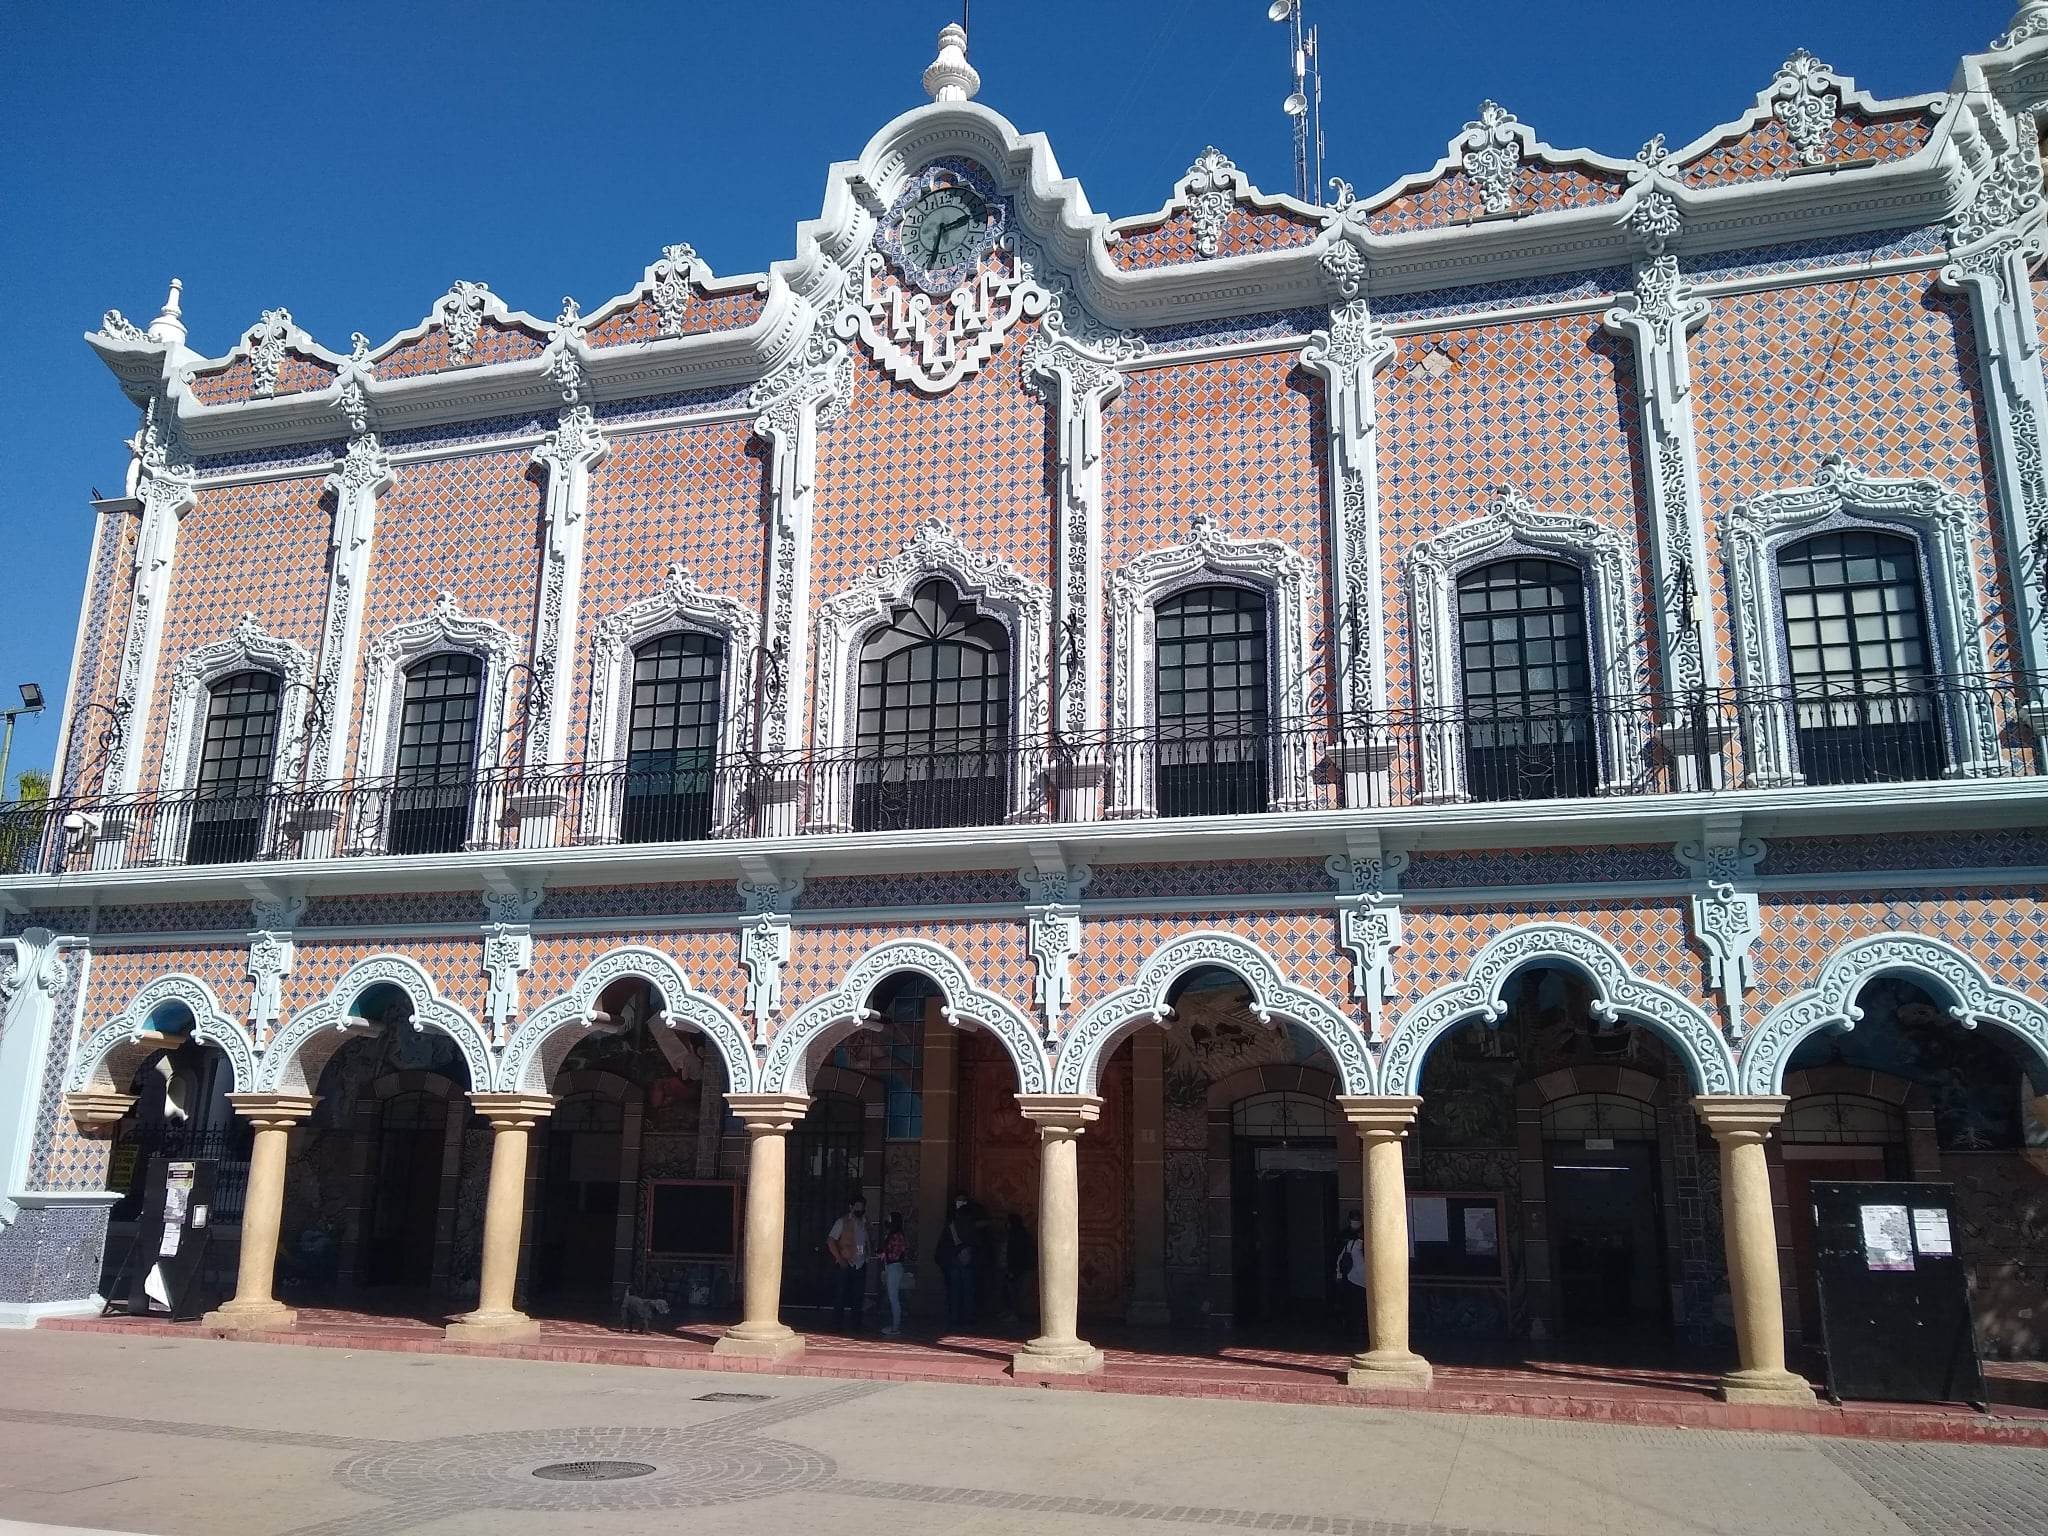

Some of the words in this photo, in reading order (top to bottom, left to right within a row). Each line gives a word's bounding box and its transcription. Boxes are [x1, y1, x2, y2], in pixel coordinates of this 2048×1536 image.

[940, 194, 953, 204] 12
[925, 202, 934, 210] 11
[912, 215, 923, 224] 10
[911, 230, 917, 239] 9
[968, 236, 974, 244] 4
[912, 245, 918, 253] 8
[956, 249, 962, 258] 5
[940, 255, 946, 264] 6
